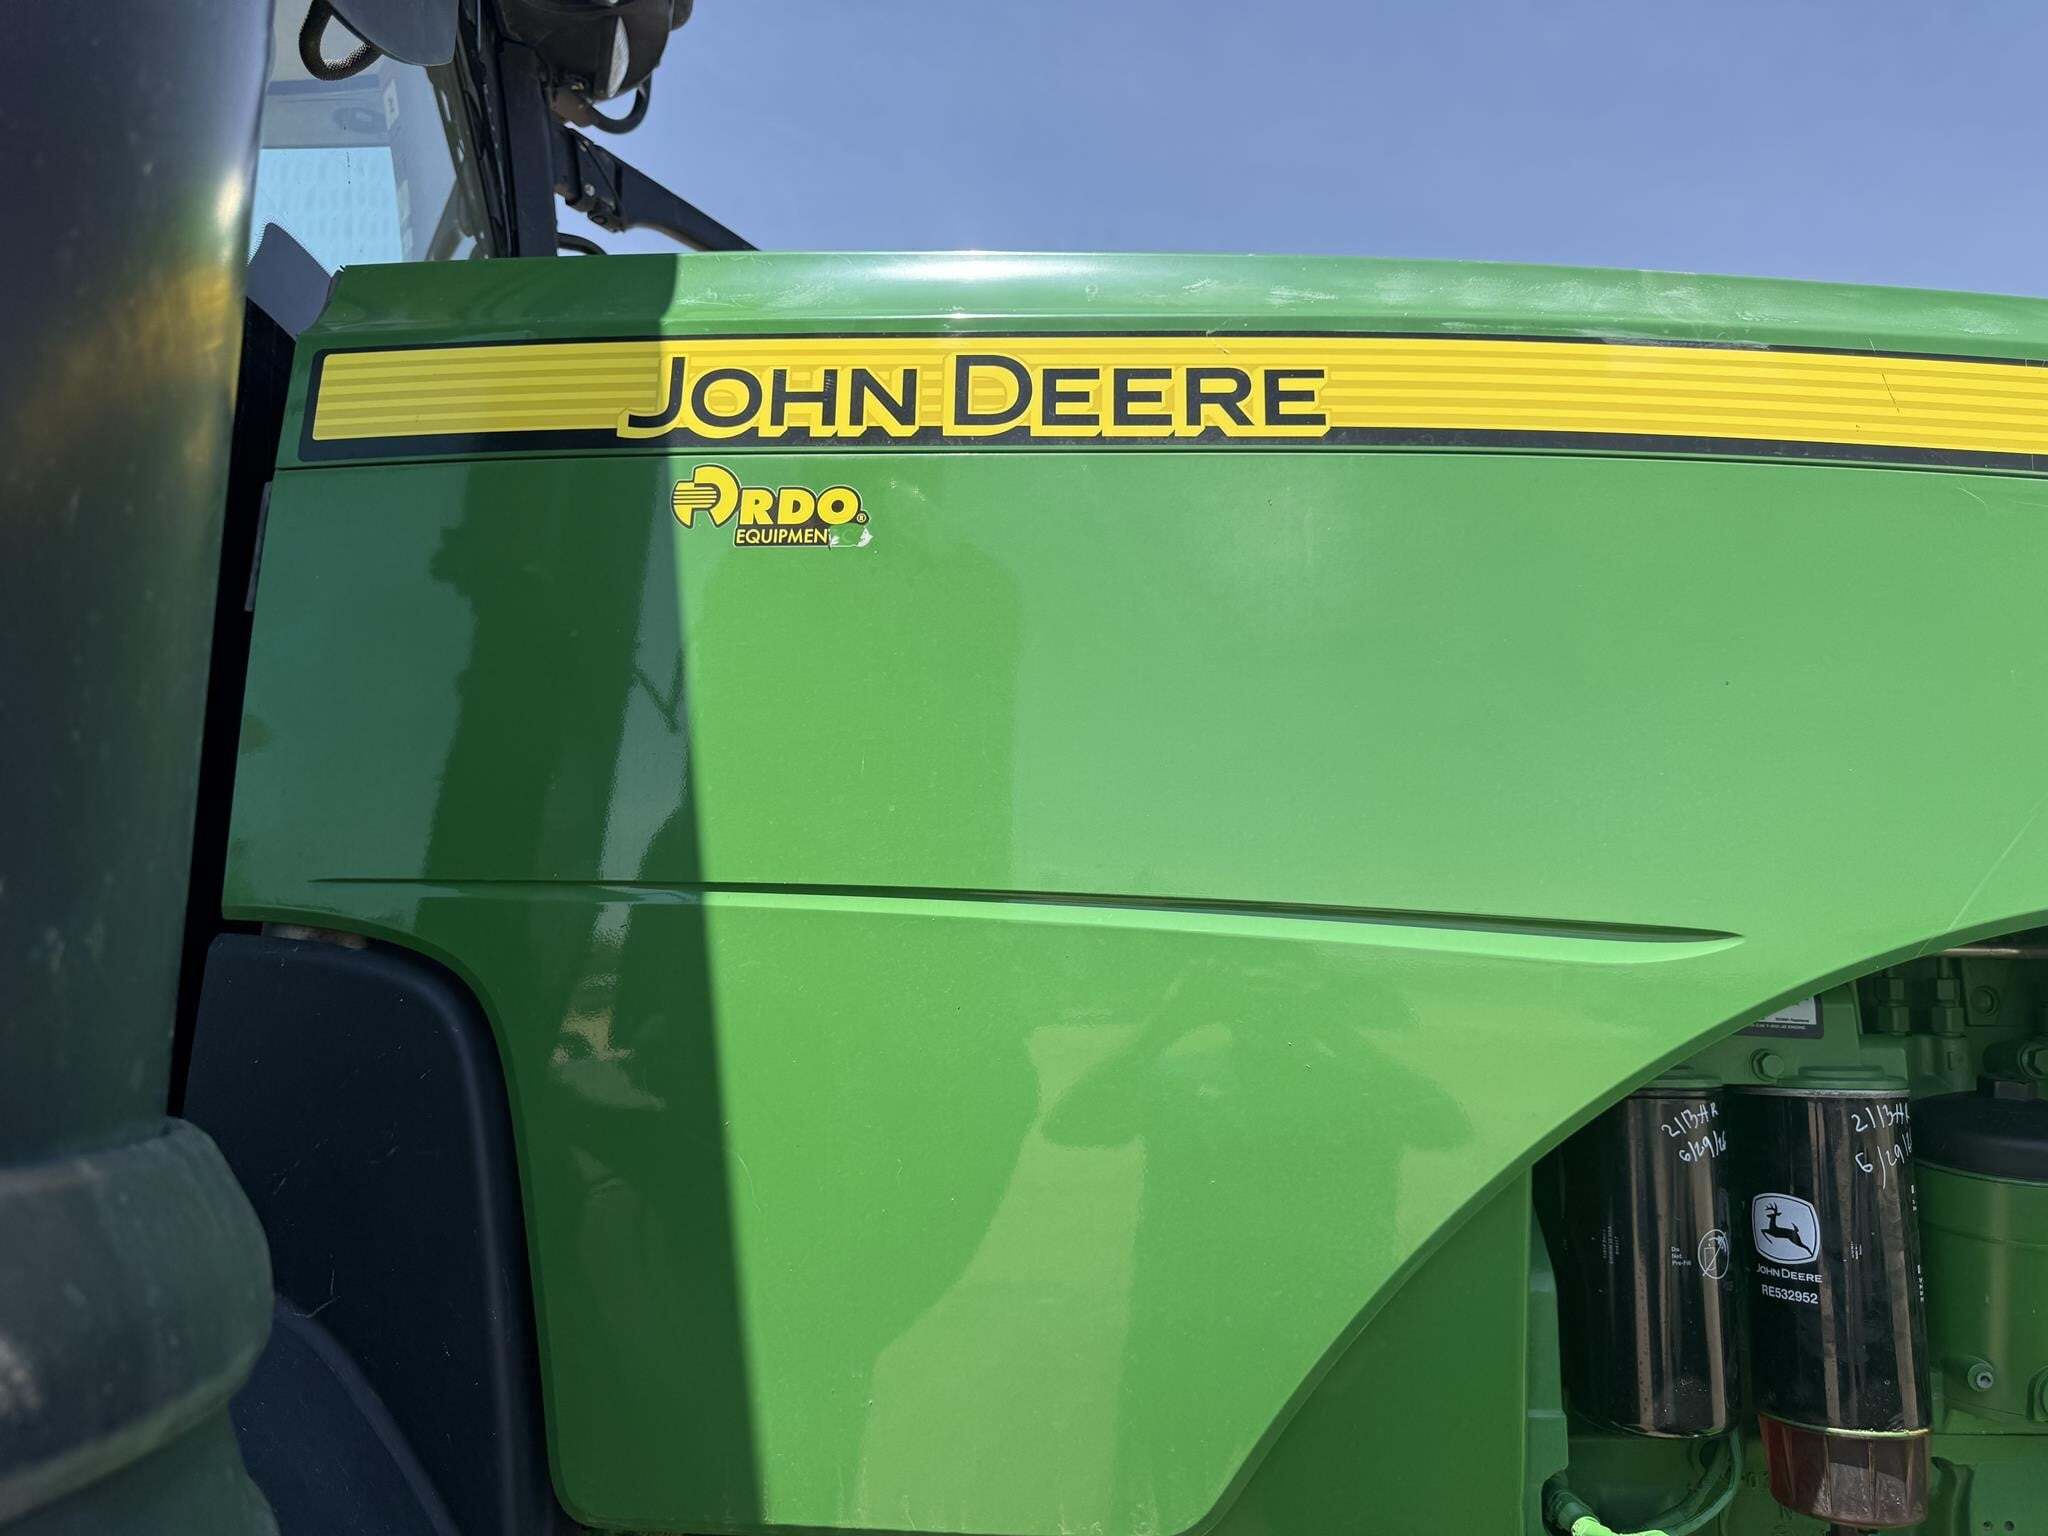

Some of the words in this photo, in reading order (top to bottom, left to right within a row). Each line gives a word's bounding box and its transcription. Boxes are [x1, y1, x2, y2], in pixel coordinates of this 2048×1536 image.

[625, 356, 918, 429] JOHN
[953, 354, 1328, 427] DEERE
[735, 528, 832, 545] EQUIPMEN
[1756, 1263, 1780, 1278] JOHN
[1781, 1268, 1823, 1283] DEERE
[1761, 1284, 1819, 1304] RE532952
